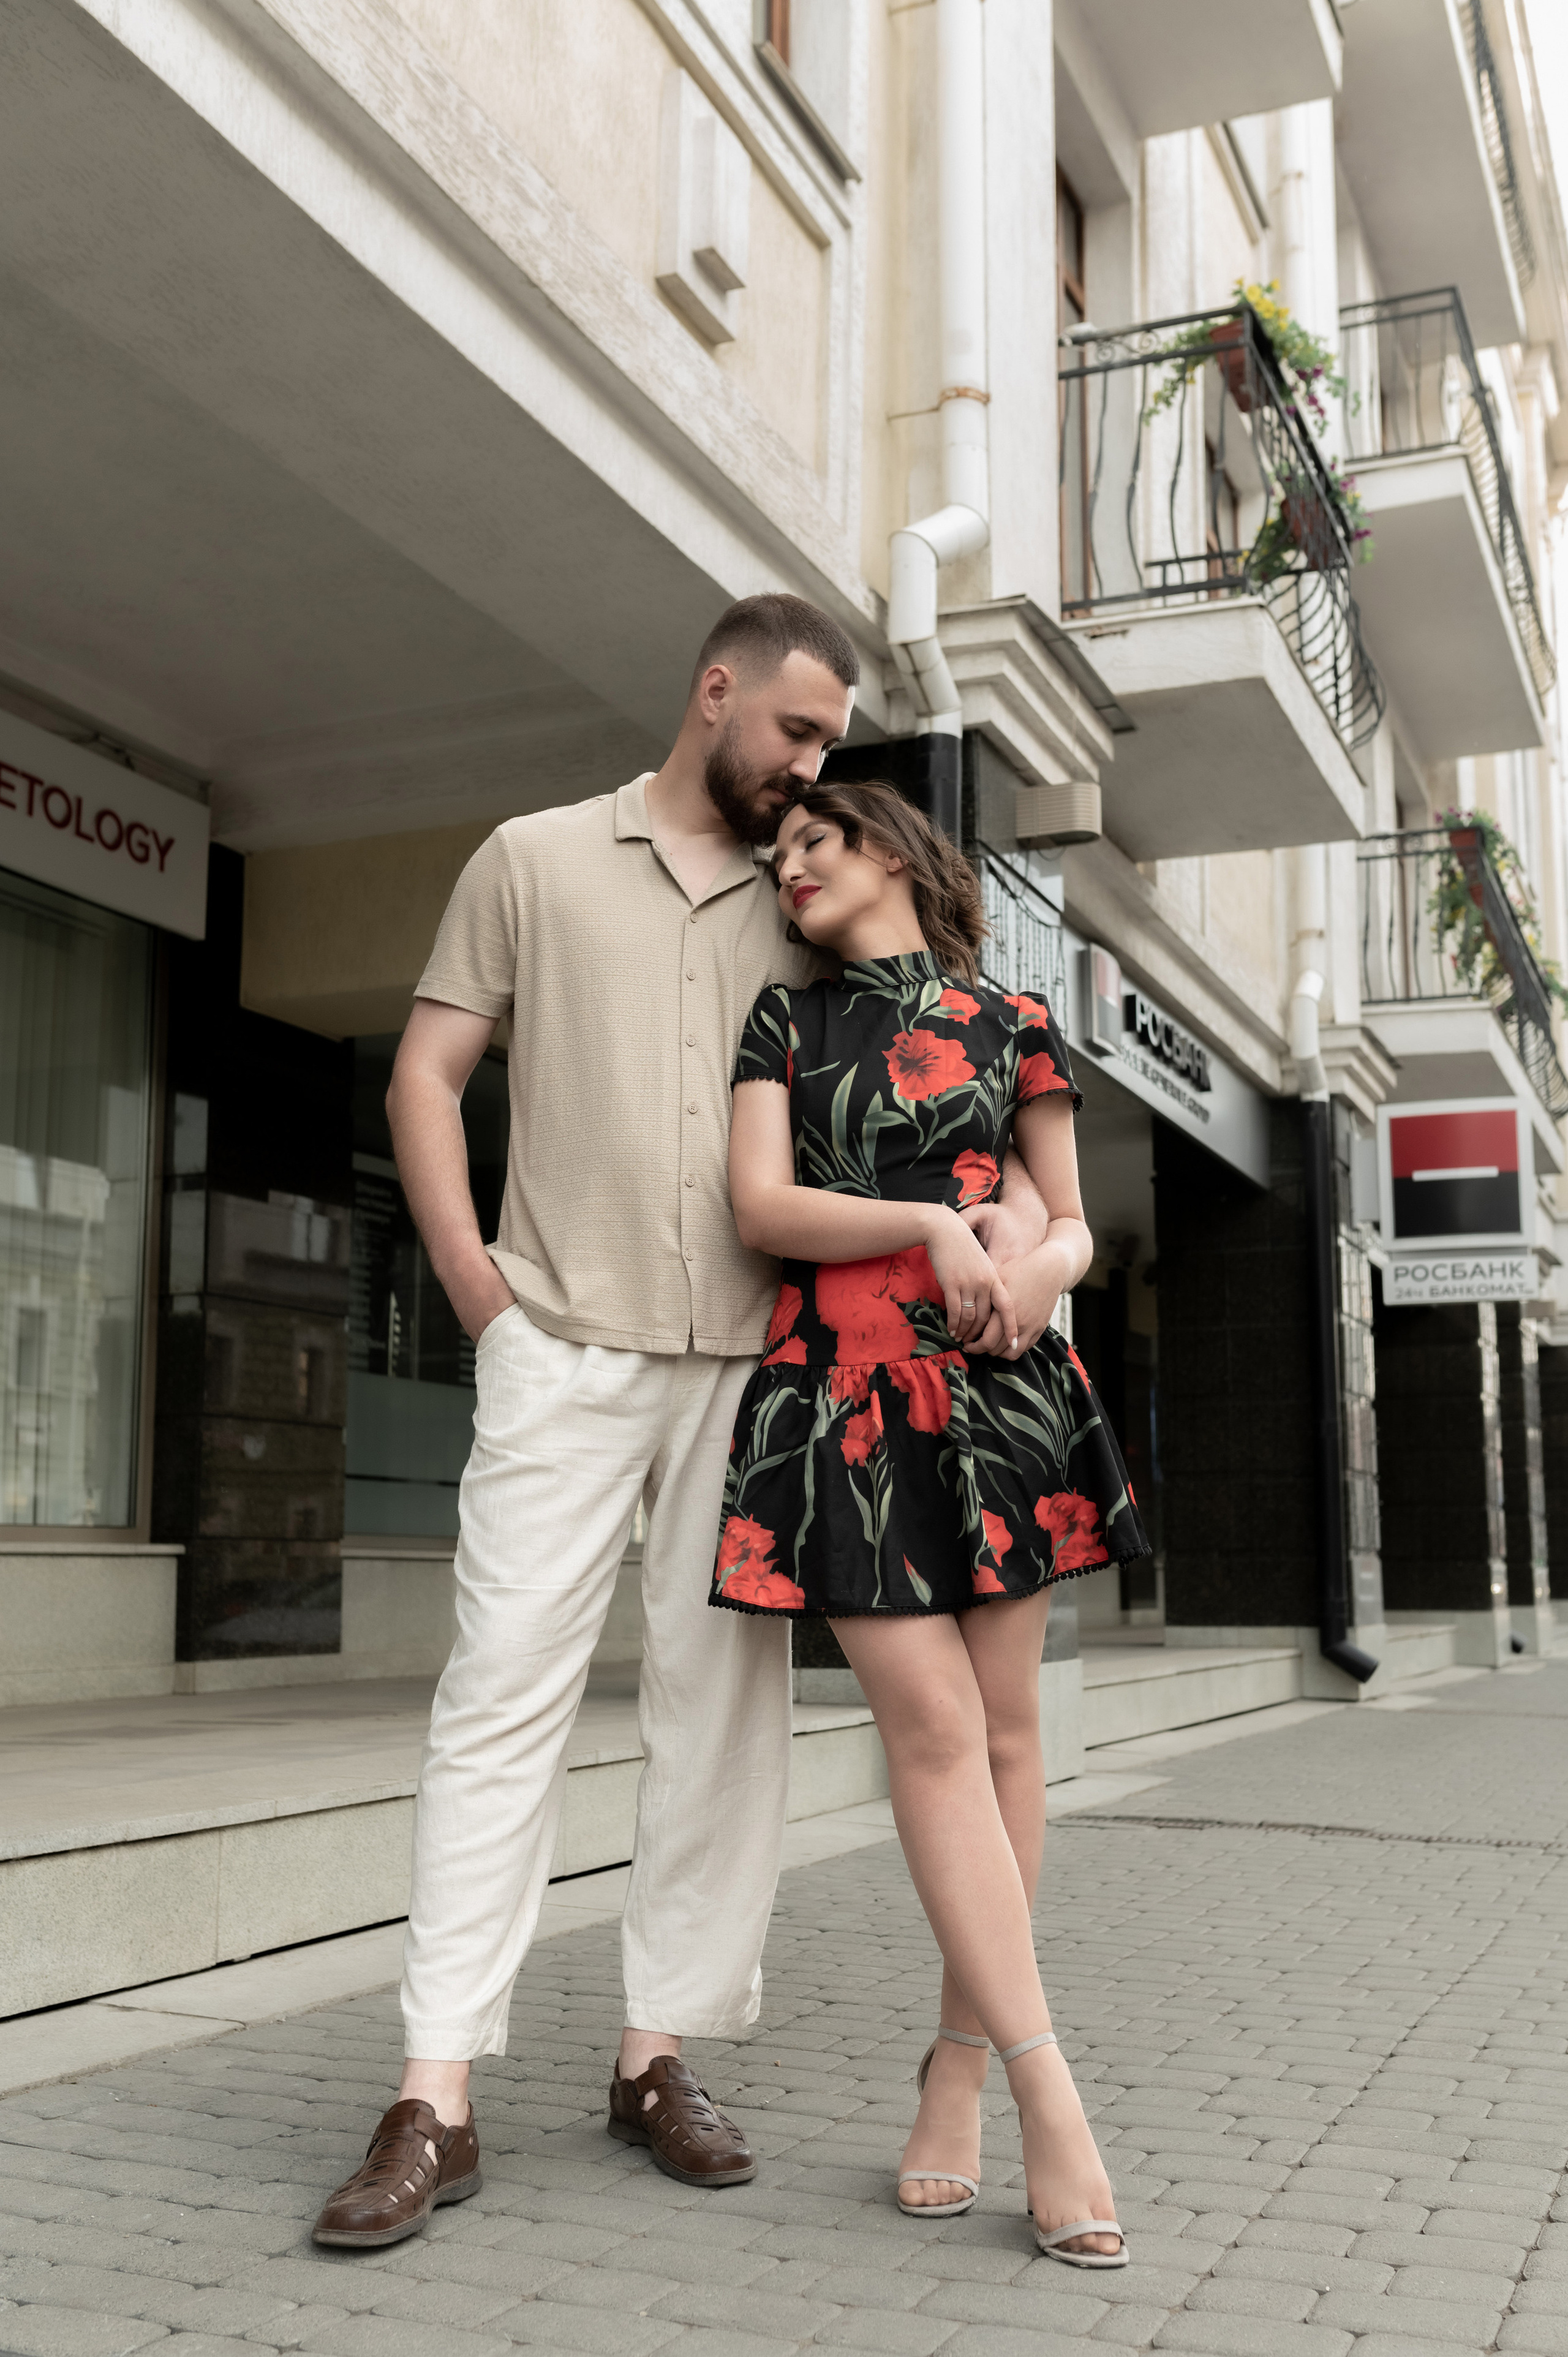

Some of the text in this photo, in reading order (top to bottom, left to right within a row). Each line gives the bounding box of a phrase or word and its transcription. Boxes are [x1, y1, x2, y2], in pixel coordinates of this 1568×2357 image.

[0, 761, 175, 873] ETOLOGY
[1394, 1261, 1525, 1283] РОСБАНК
[1429, 1283, 1525, 1299] БАНКОМАТ
